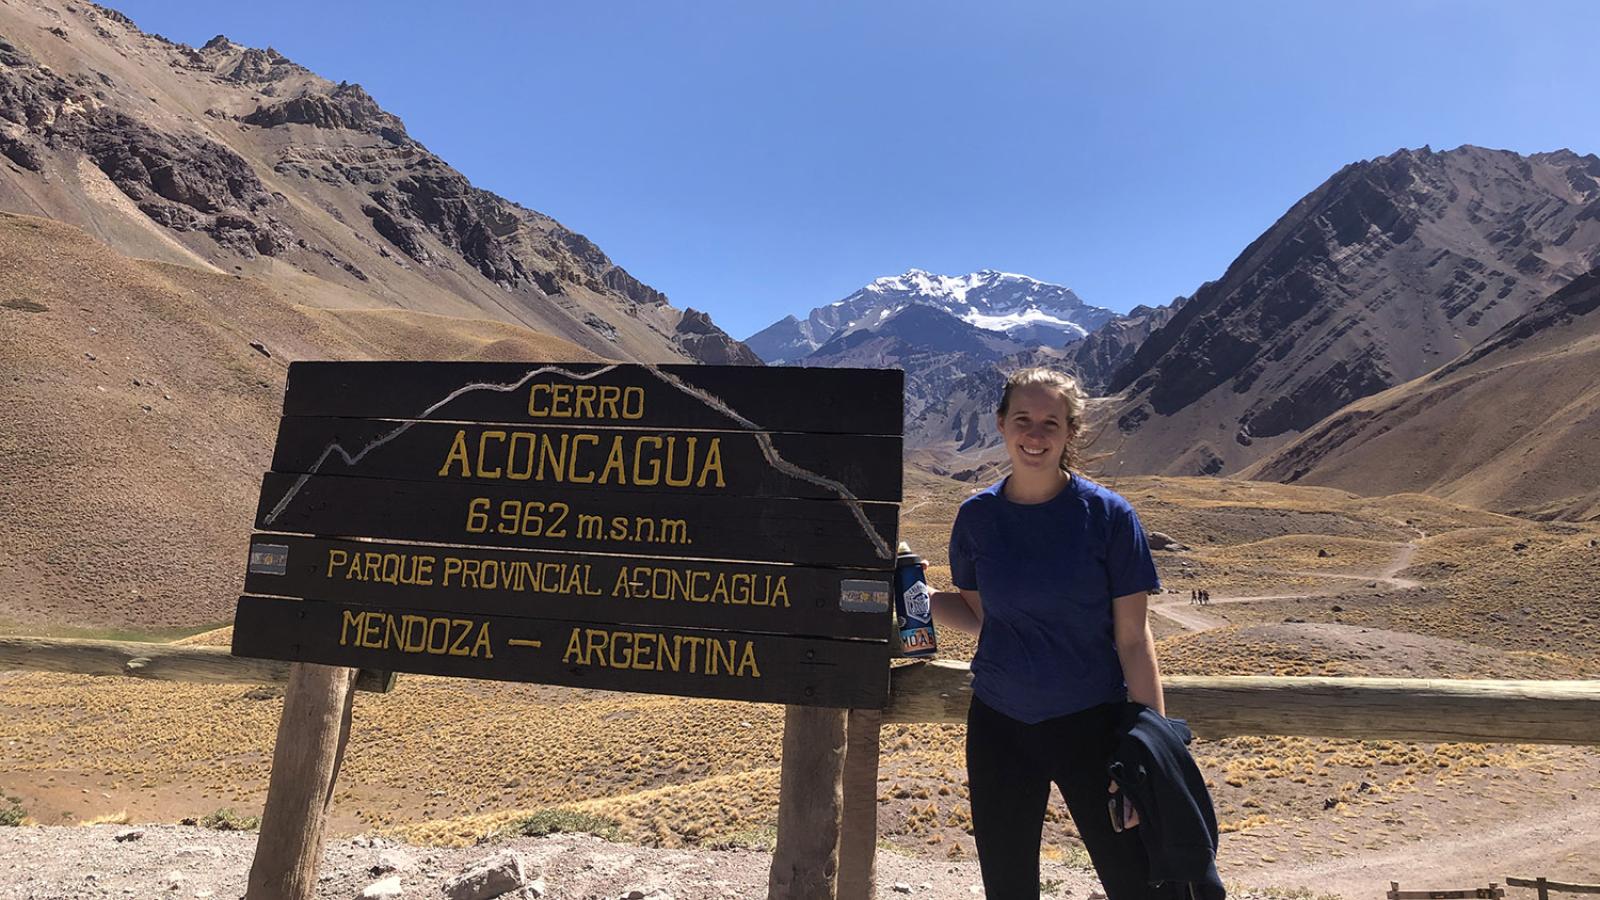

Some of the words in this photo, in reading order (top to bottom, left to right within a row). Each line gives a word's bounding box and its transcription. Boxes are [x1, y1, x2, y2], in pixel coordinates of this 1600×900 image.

[528, 383, 645, 419] CERRO
[438, 430, 725, 488] ACONCAGUA
[466, 497, 569, 538] 6.962
[576, 513, 692, 545] m.s.n.m.
[327, 549, 436, 585] PARQUE
[442, 557, 602, 597] PROVINCIAL
[611, 566, 791, 609] ACONCAGUA
[339, 610, 493, 659] MENDOZA
[563, 628, 760, 678] ARGENTINA
